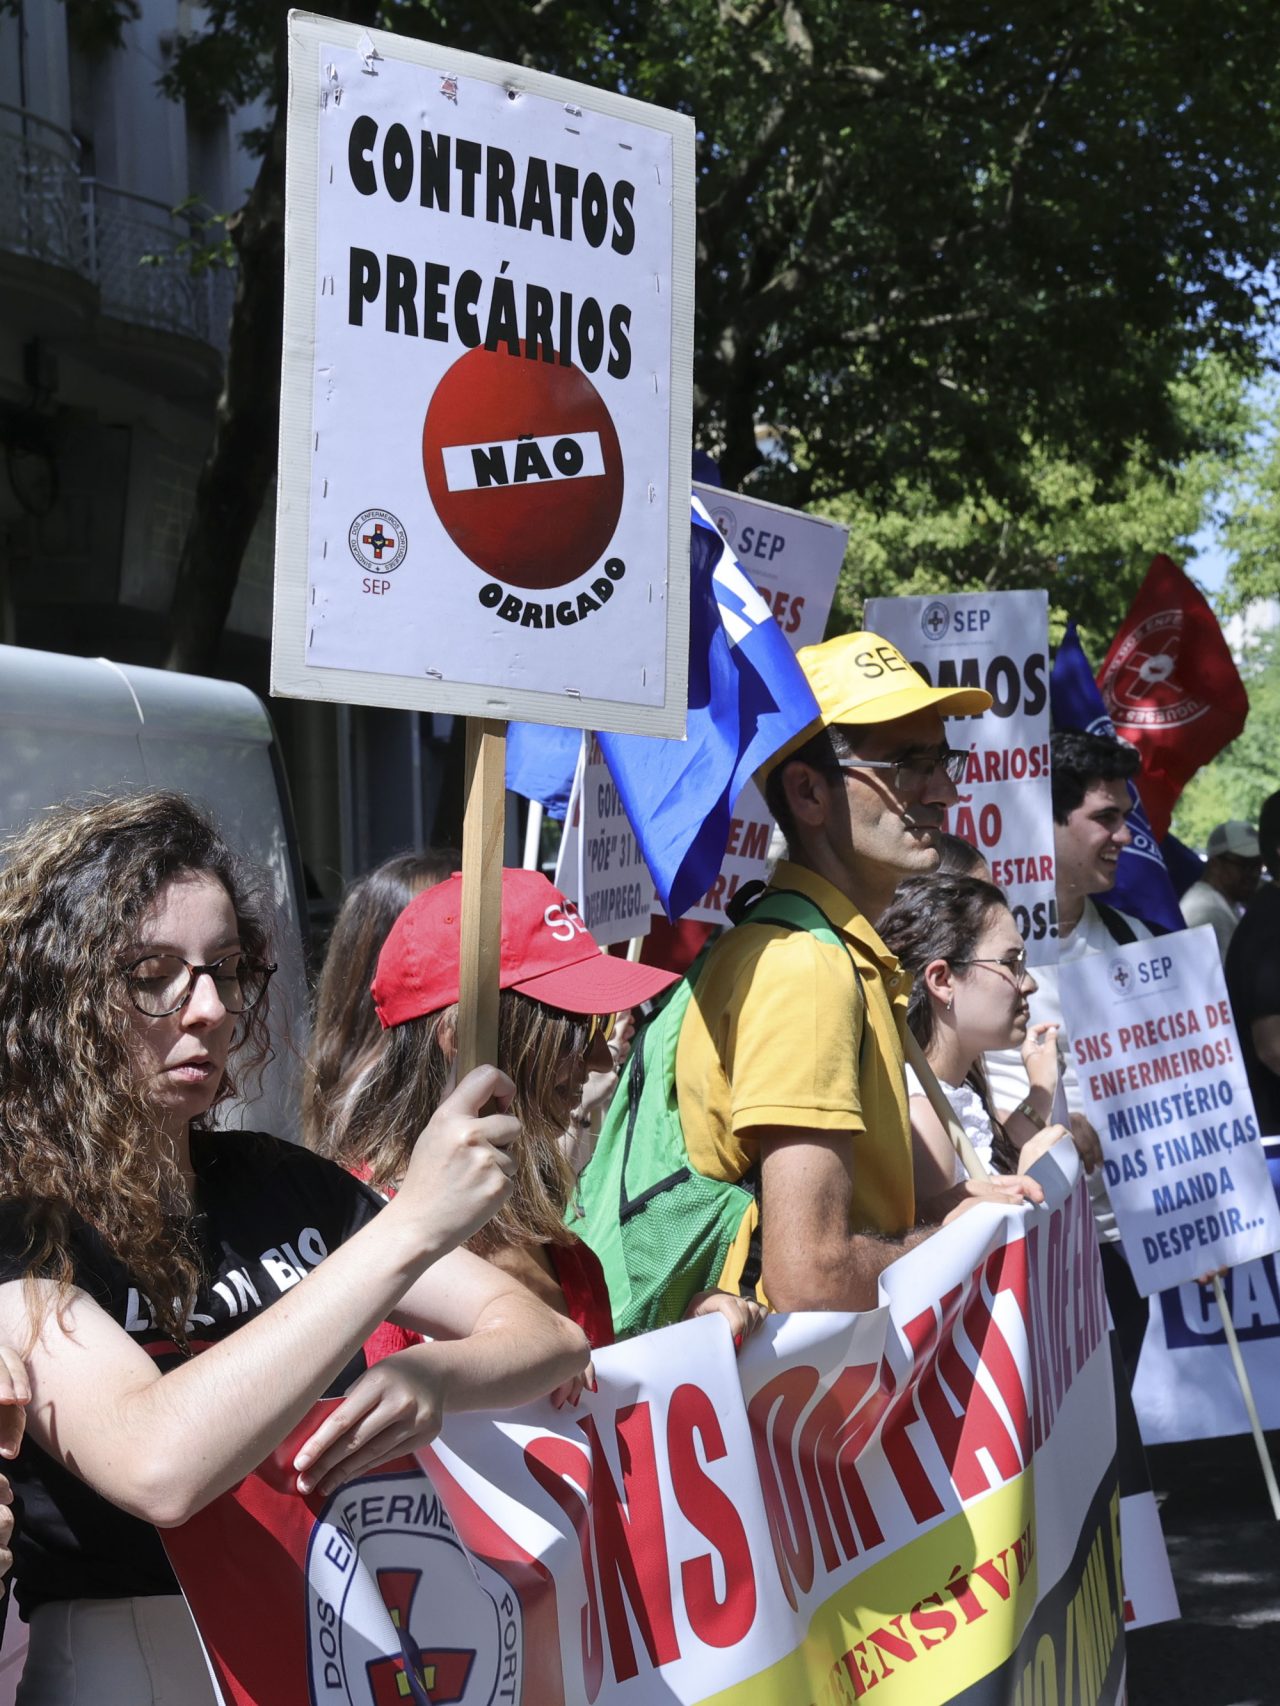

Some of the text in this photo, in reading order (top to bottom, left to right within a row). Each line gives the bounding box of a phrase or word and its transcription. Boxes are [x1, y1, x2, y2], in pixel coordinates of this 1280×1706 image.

[348, 115, 636, 257] CONTRATOS
[348, 246, 632, 380] PRECÁRIOS
[471, 433, 584, 488] NÃO
[738, 526, 785, 561] SEP
[362, 577, 391, 595] SEP
[478, 556, 627, 630] OBRIGADO
[953, 609, 991, 633] SEP
[956, 743, 1050, 785] ÁRIOS!
[991, 855, 1055, 887] ESTAR
[1012, 898, 1059, 942] OS!
[1138, 956, 1173, 984] SEP
[1075, 1000, 1231, 1066] SNS PRECISA DE
[1089, 1038, 1235, 1101] ENFERMEIROS!
[1107, 1080, 1234, 1141] MINISTÉRIO
[1105, 1115, 1258, 1187] DAS FINANÇAS
[1152, 1167, 1235, 1217] MANDA
[1142, 1206, 1266, 1265] DESPEDIR...
[212, 1266, 263, 1318] IN
[260, 1227, 327, 1293] BIO
[524, 1383, 757, 1705] SNS
[317, 1598, 342, 1690] DOS
